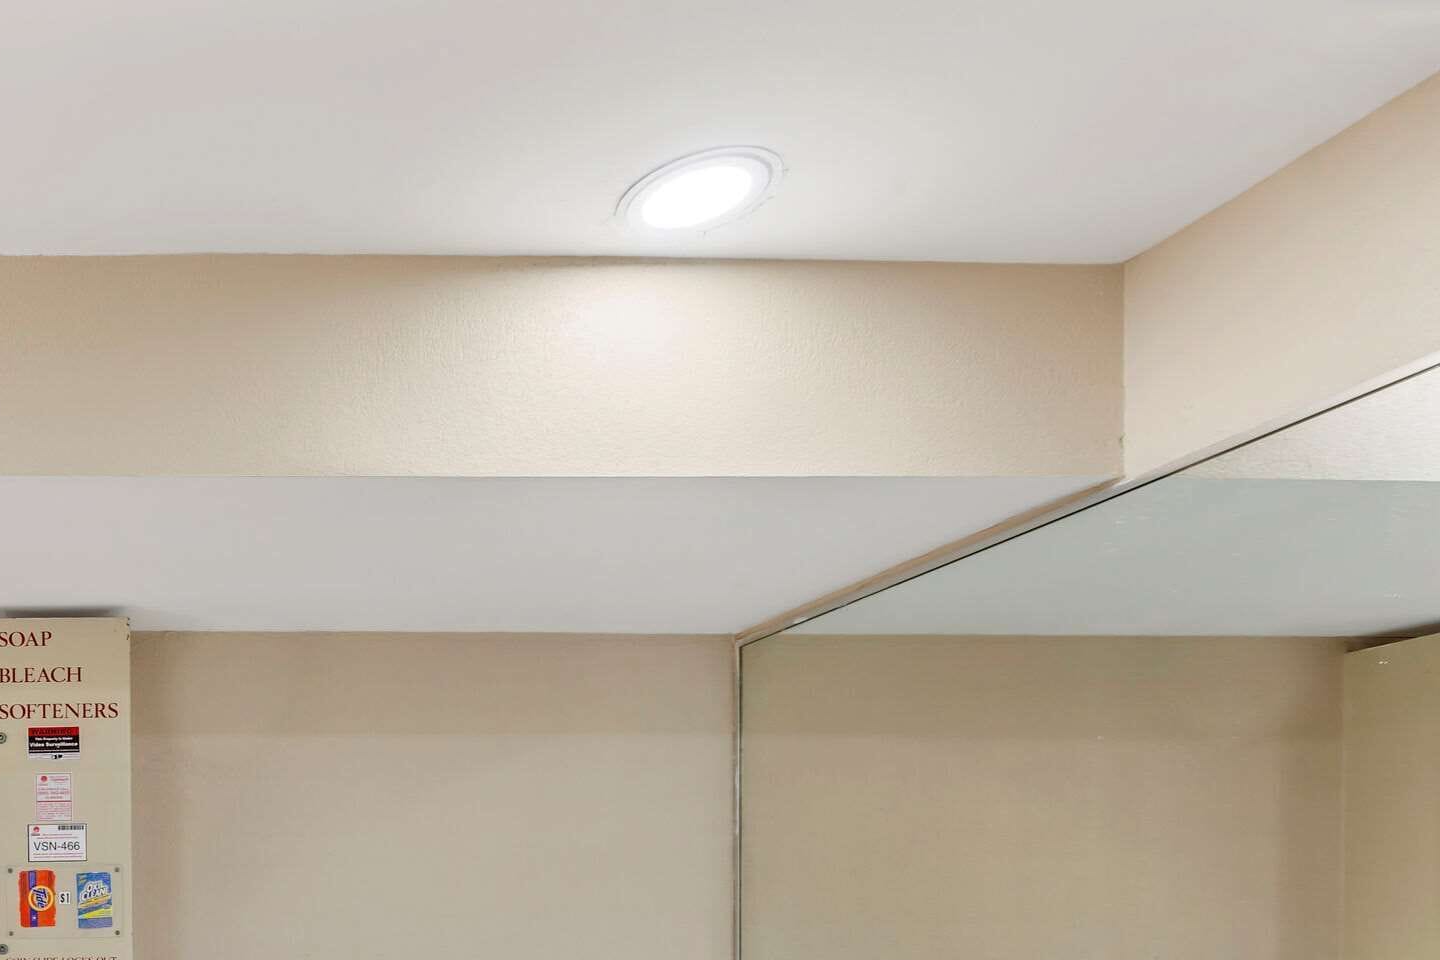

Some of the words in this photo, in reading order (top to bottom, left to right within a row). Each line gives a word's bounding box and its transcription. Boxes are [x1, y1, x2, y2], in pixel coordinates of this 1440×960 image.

[0, 666, 82, 684] BLEACH
[33, 841, 81, 851] VSN-466
[32, 887, 47, 908] Tide
